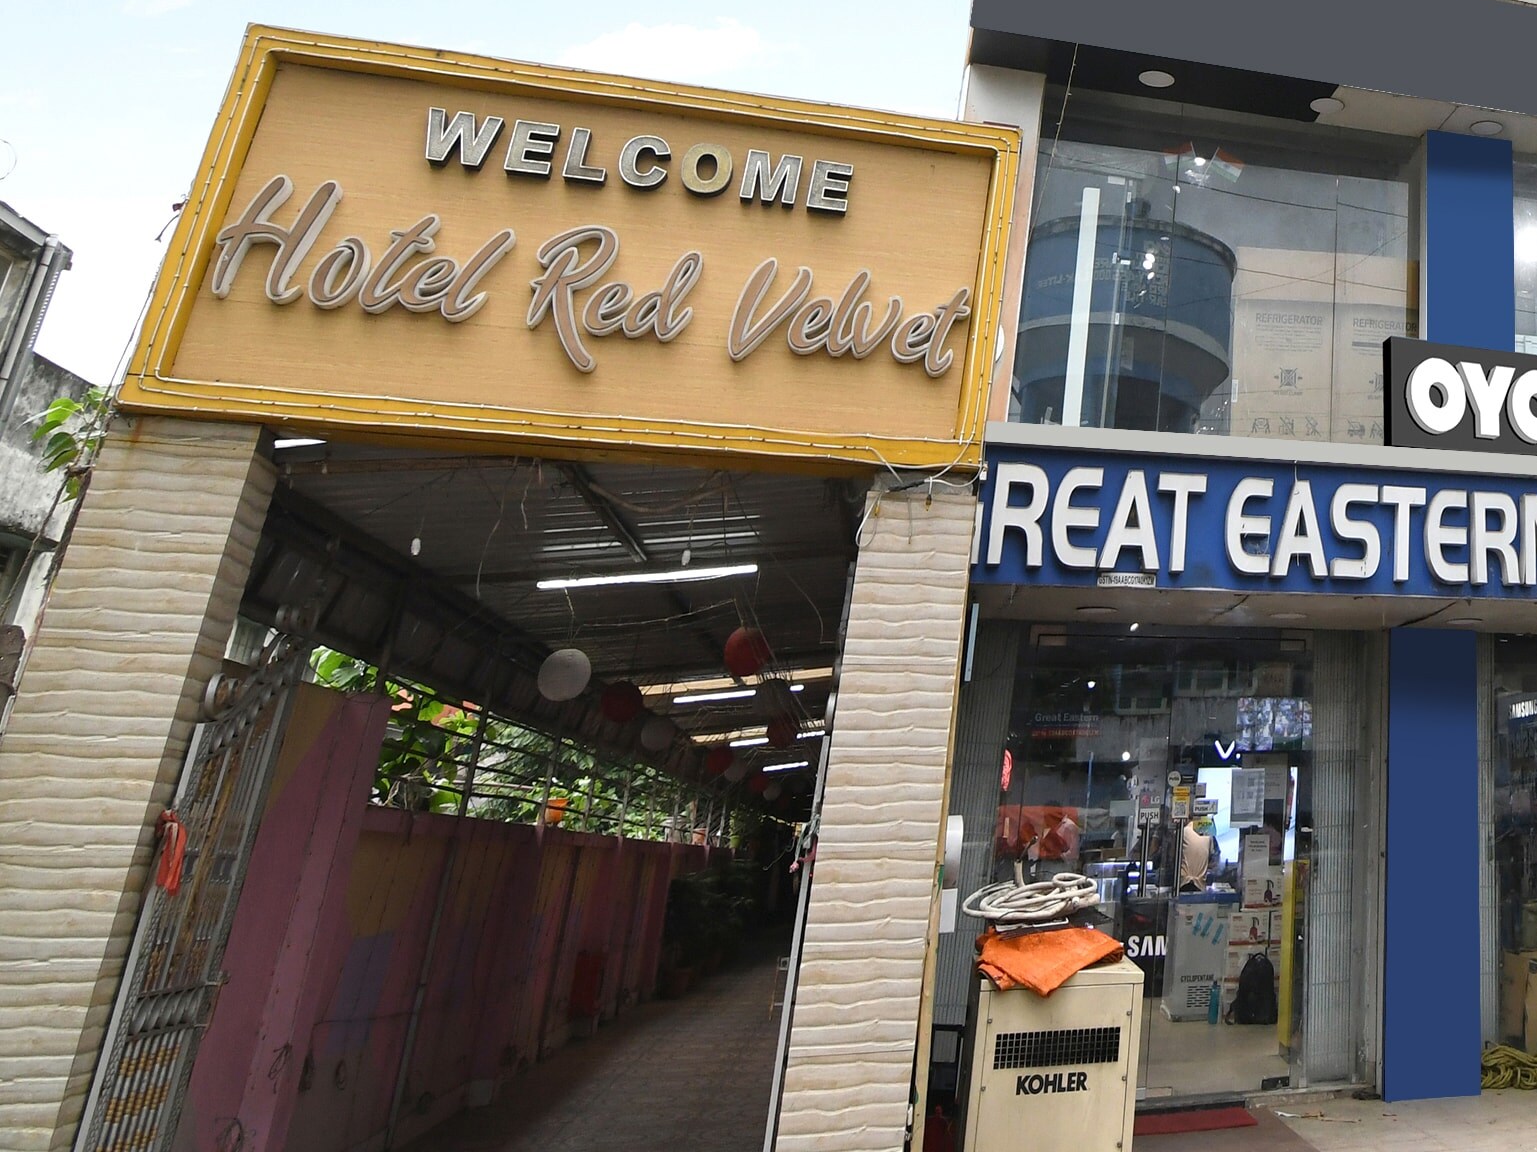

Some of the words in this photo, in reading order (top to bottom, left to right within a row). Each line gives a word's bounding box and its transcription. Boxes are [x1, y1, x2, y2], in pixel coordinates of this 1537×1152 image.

[425, 106, 856, 217] WELCOME
[211, 175, 517, 323] Hotel
[527, 224, 703, 374] Red
[728, 255, 973, 379] Velvet
[1255, 312, 1324, 326] REFRIGERATOR
[1352, 317, 1418, 332] REFRIGERATOR
[972, 461, 1208, 572] REAT
[1034, 712, 1062, 722] Great
[1150, 795, 1161, 804] LG
[1140, 811, 1159, 820] PUSH
[1016, 1071, 1088, 1096] KOHLER
